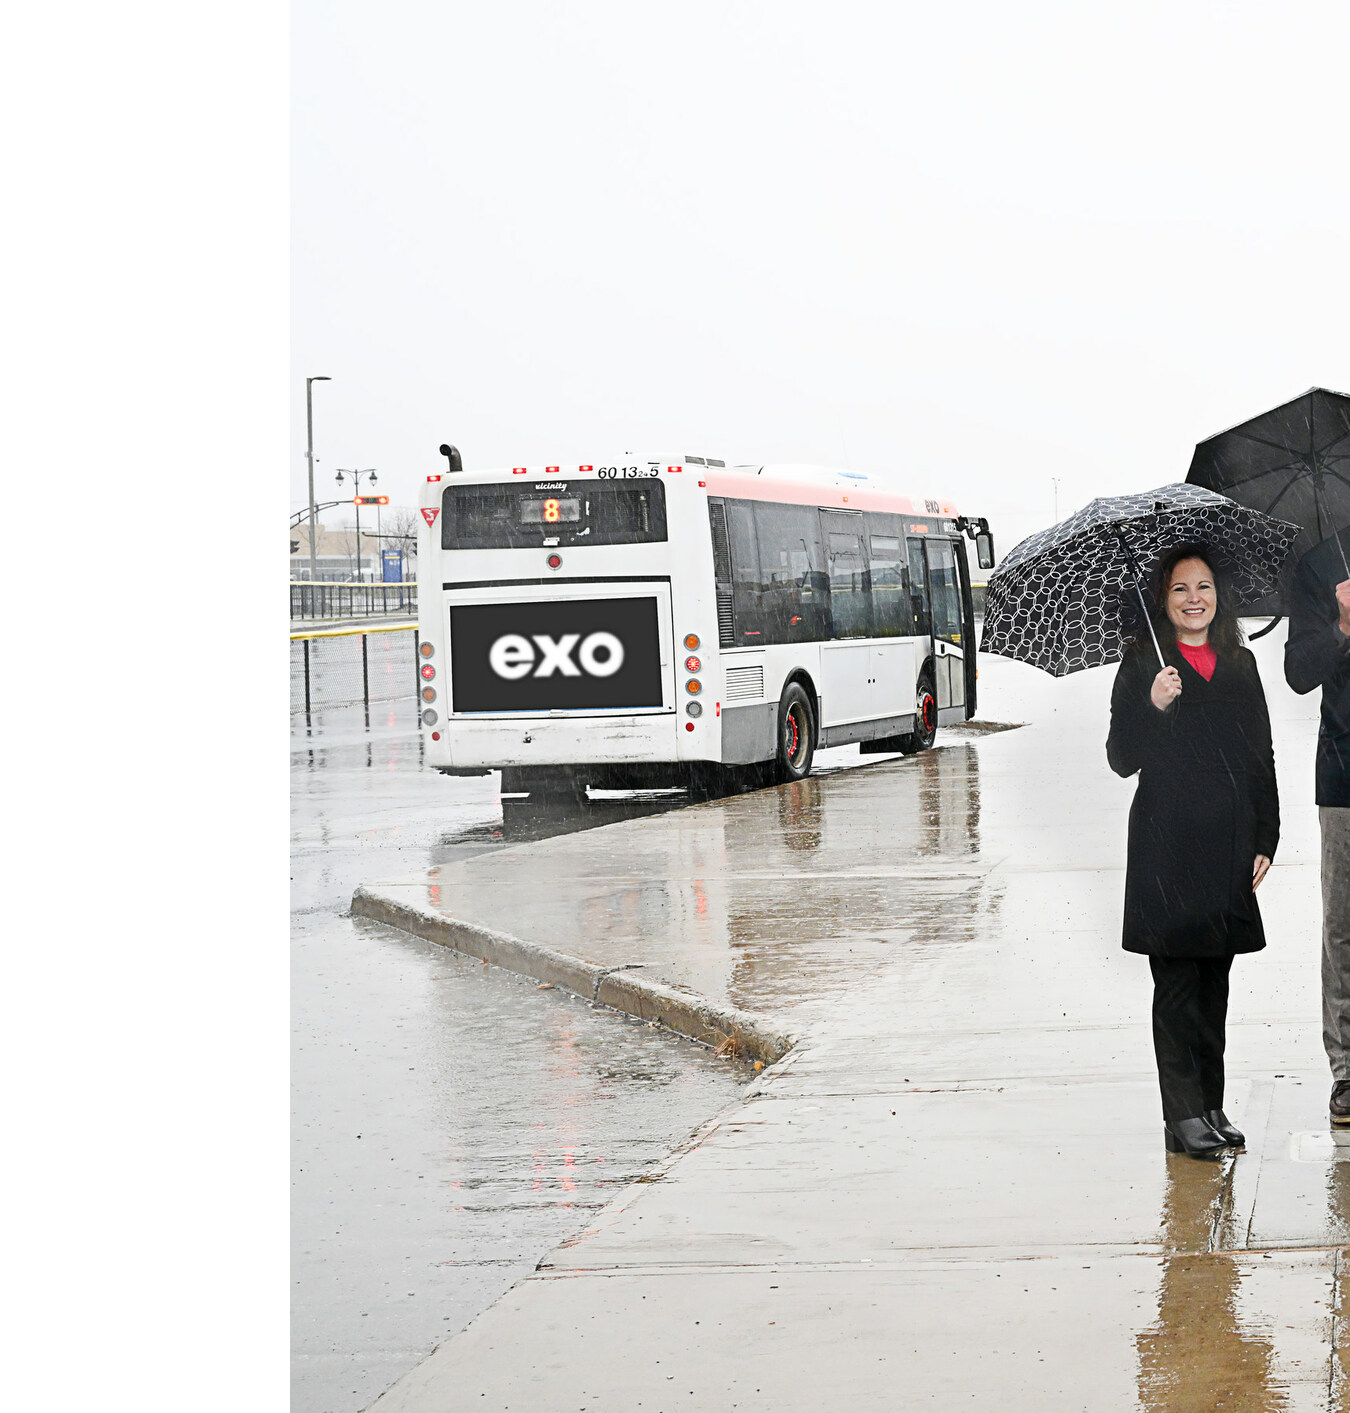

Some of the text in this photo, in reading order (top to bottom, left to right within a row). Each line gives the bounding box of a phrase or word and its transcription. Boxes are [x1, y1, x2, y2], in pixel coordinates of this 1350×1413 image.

[535, 482, 567, 491] vicinity
[544, 498, 560, 522] 8
[925, 500, 940, 514] exo
[490, 631, 624, 680] exo
